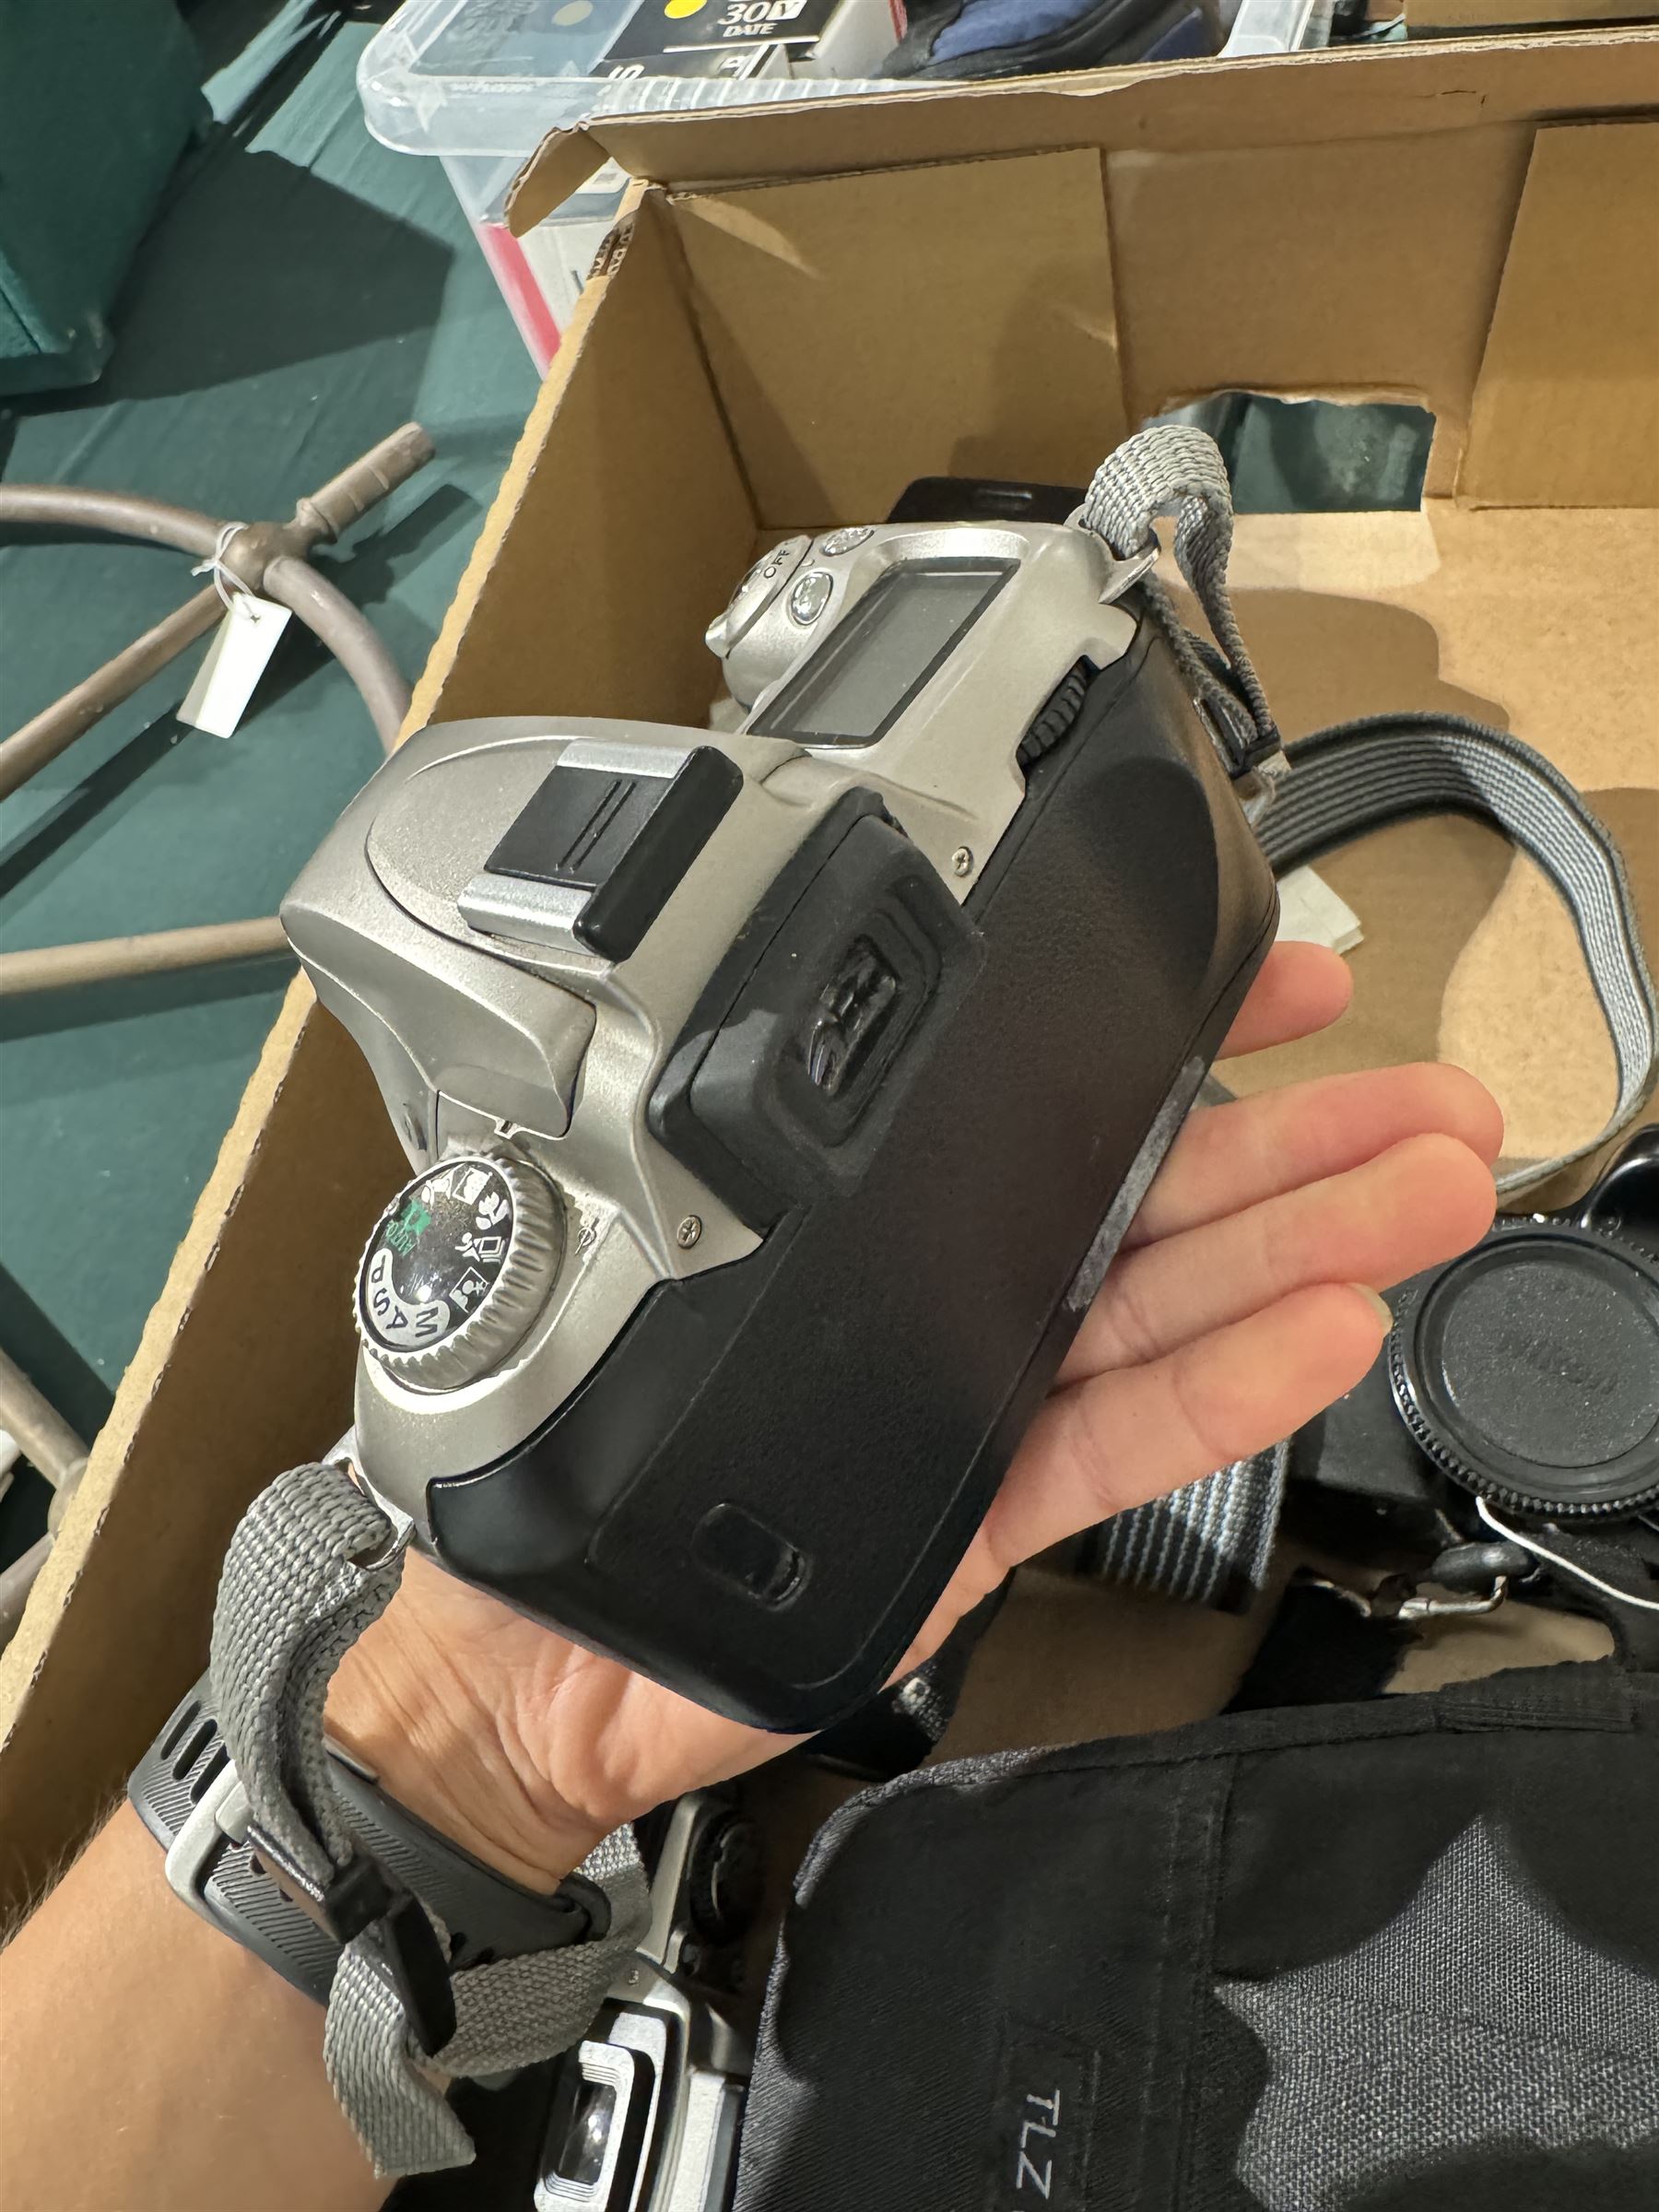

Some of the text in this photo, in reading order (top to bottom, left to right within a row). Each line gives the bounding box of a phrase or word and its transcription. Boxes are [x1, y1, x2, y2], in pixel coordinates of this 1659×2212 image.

[723, 22, 778, 37] DATE
[763, 549, 790, 579] OFF
[1016, 2088, 1060, 2199] TLZ
